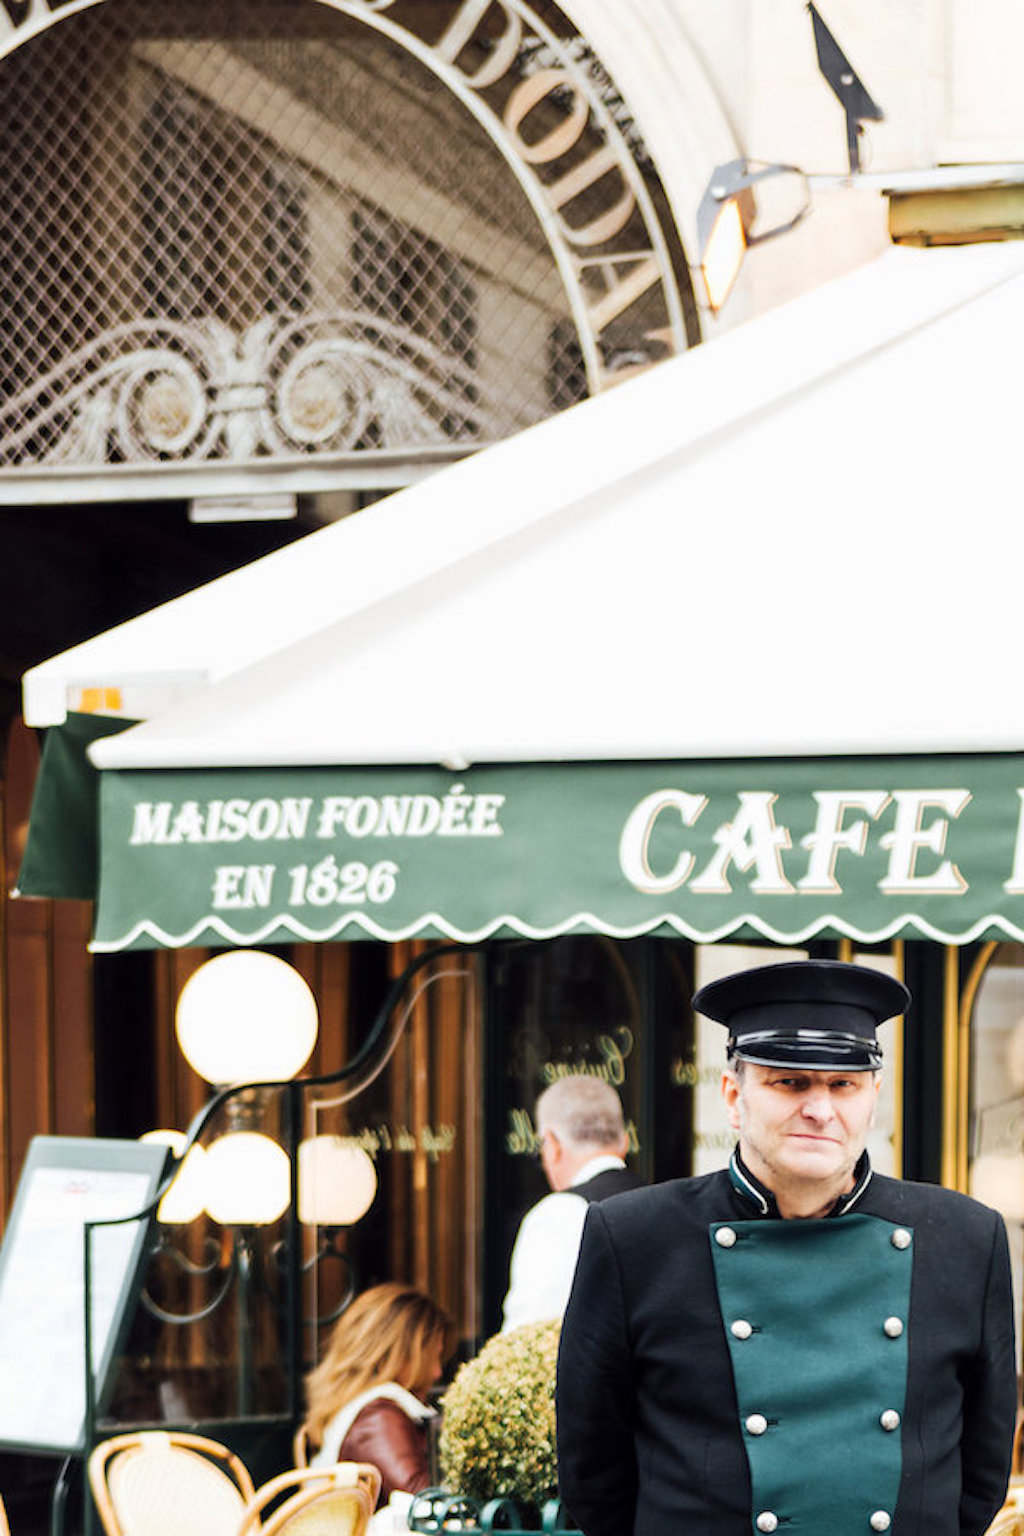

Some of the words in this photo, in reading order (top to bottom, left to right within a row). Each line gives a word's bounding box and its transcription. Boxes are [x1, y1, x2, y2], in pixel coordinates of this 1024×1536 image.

[129, 797, 311, 845] MAISON
[318, 784, 504, 838] FONDÉE
[618, 788, 972, 896] CAFE
[211, 865, 275, 910] EN
[288, 856, 398, 907] 1826
